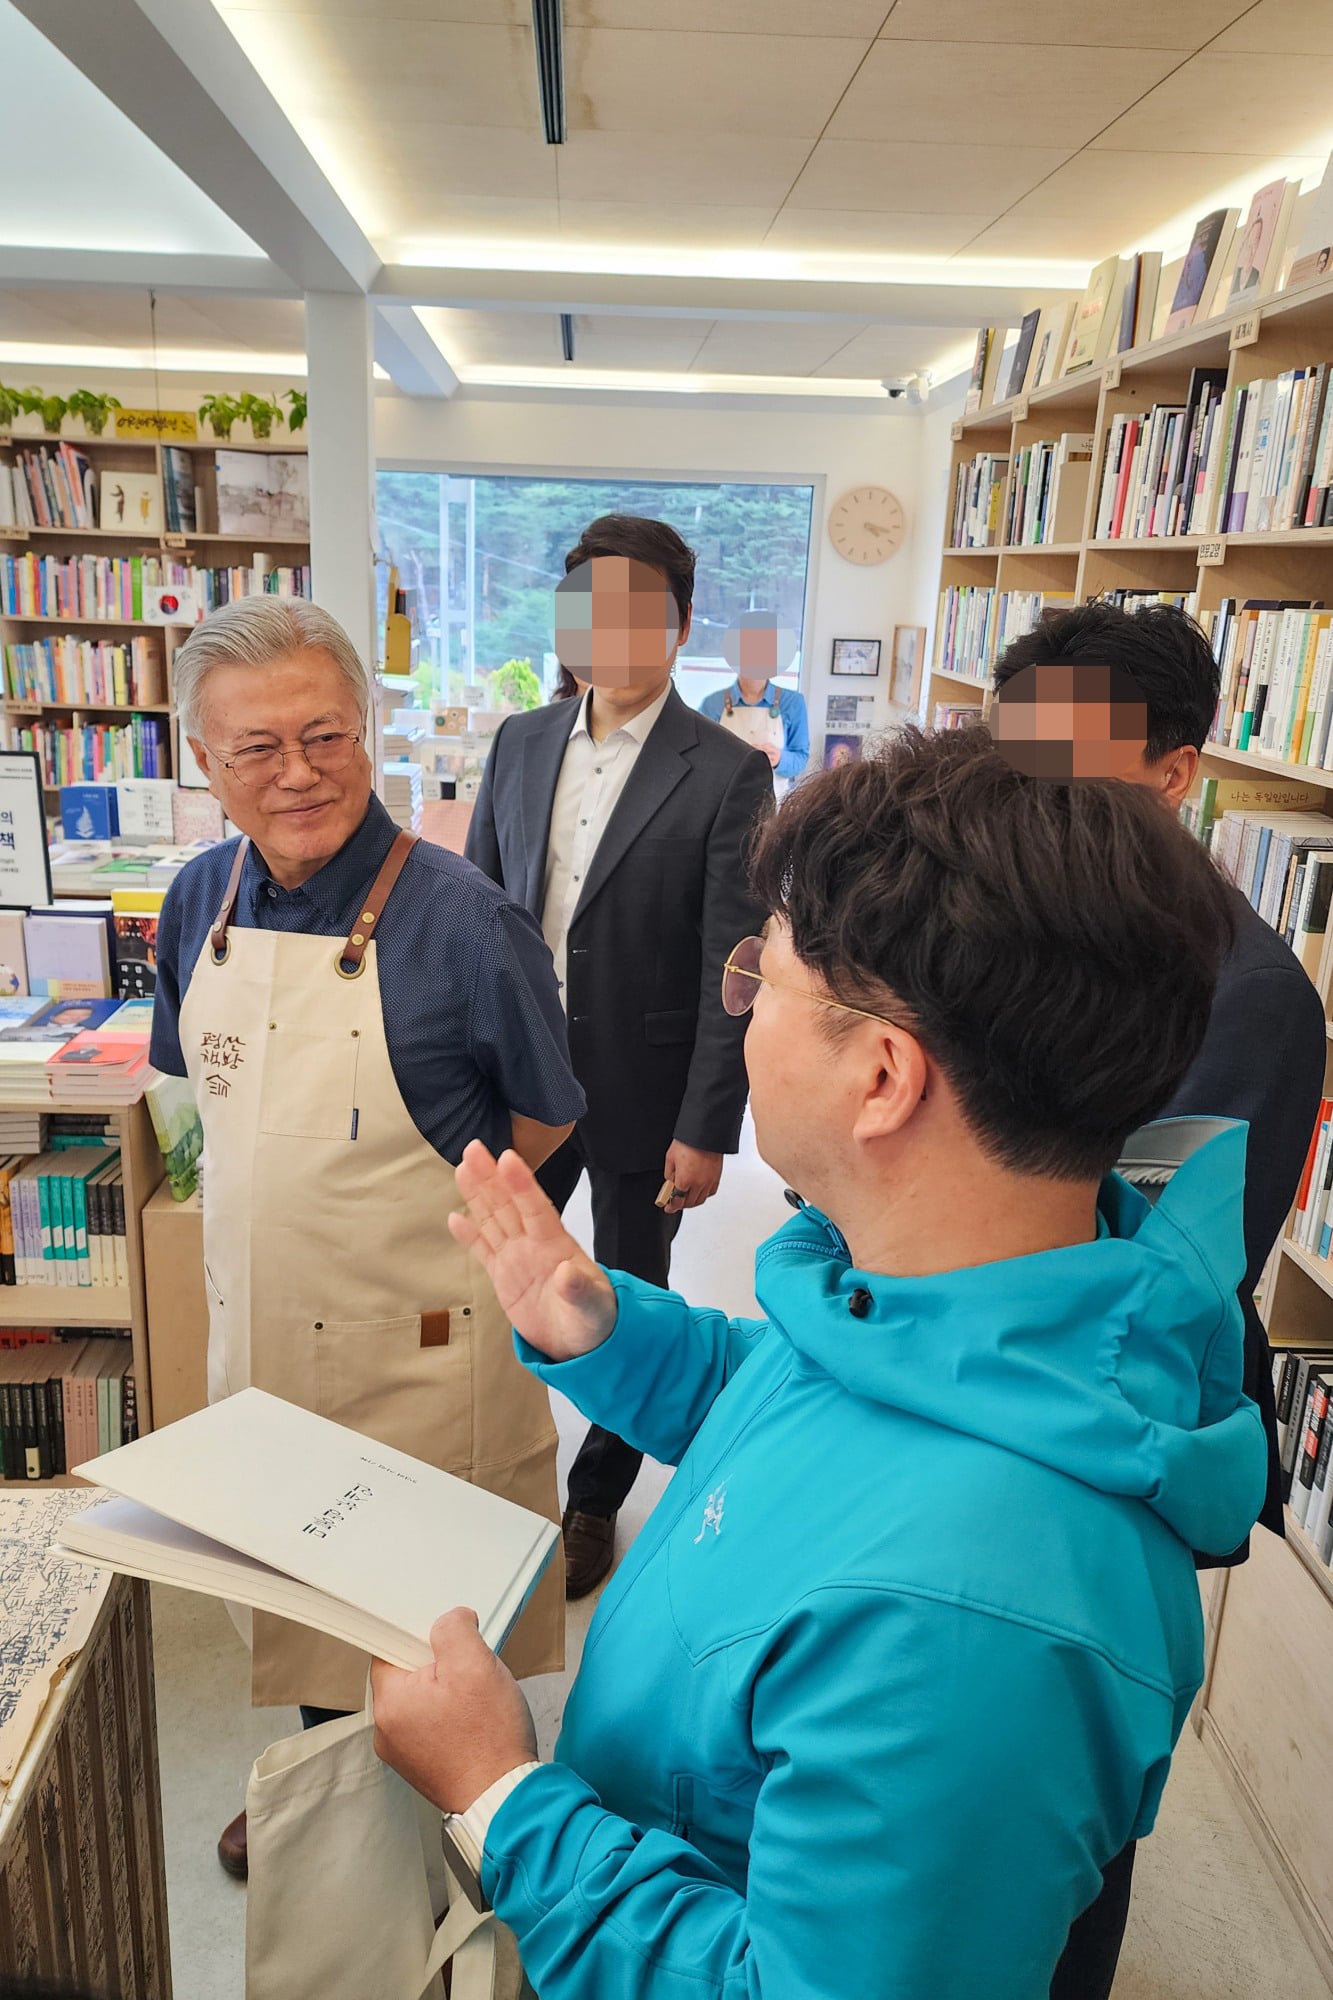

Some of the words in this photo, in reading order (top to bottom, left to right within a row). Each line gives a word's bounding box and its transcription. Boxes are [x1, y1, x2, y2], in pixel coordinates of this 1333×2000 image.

[1231, 791, 1250, 803] 나는
[1254, 791, 1310, 804] 독일인입니다
[200, 1032, 247, 1052] 평산
[200, 1048, 245, 1070] 책방
